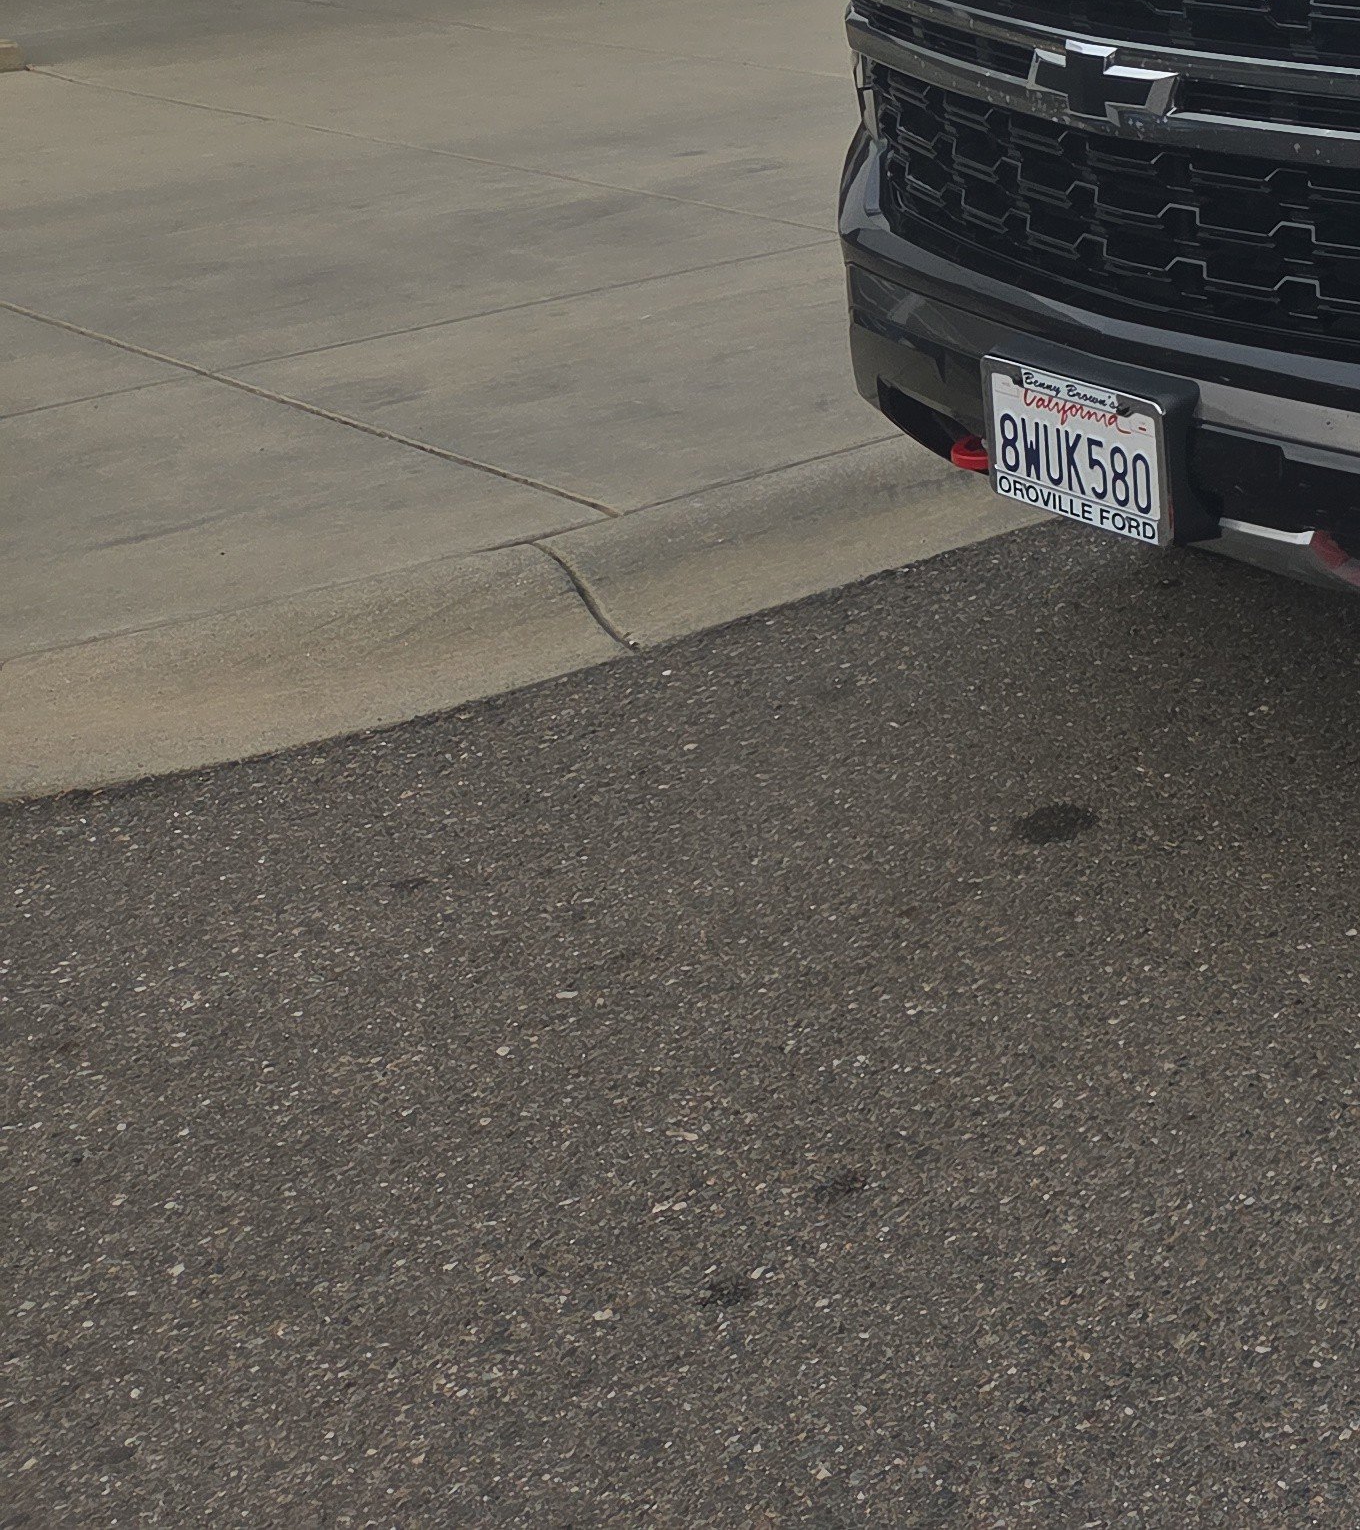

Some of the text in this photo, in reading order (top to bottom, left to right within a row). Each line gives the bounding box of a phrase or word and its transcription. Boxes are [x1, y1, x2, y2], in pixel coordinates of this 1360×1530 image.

[1023, 371, 1119, 410] Benny Brown's
[1024, 388, 1131, 434] California
[1000, 413, 1151, 514] 8WUK580
[999, 476, 1156, 540] OROVILLE FORD
